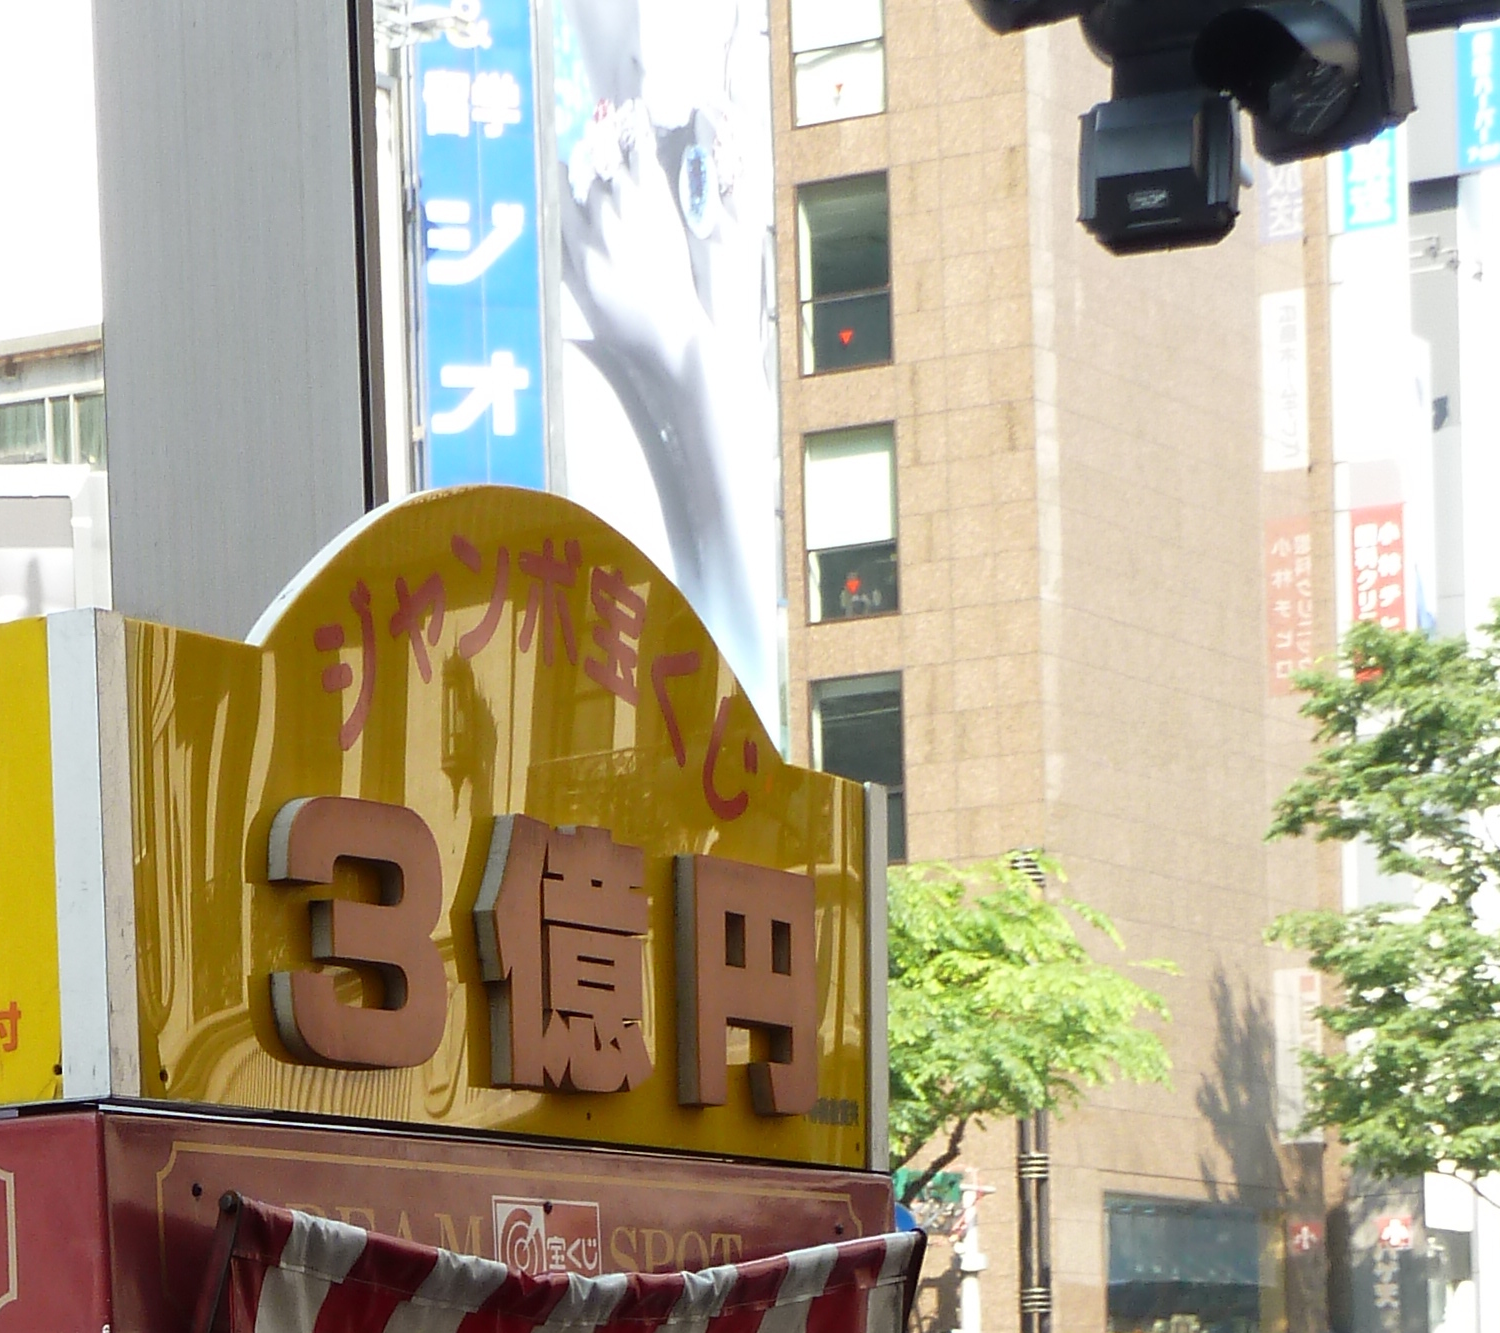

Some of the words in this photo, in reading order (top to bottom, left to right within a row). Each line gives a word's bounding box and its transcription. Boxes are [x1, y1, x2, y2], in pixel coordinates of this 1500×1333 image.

[314, 534, 758, 821] ジャンボ宝くじ
[268, 796, 817, 1116] 3億円
[547, 1237, 599, 1271] 宝くじ
